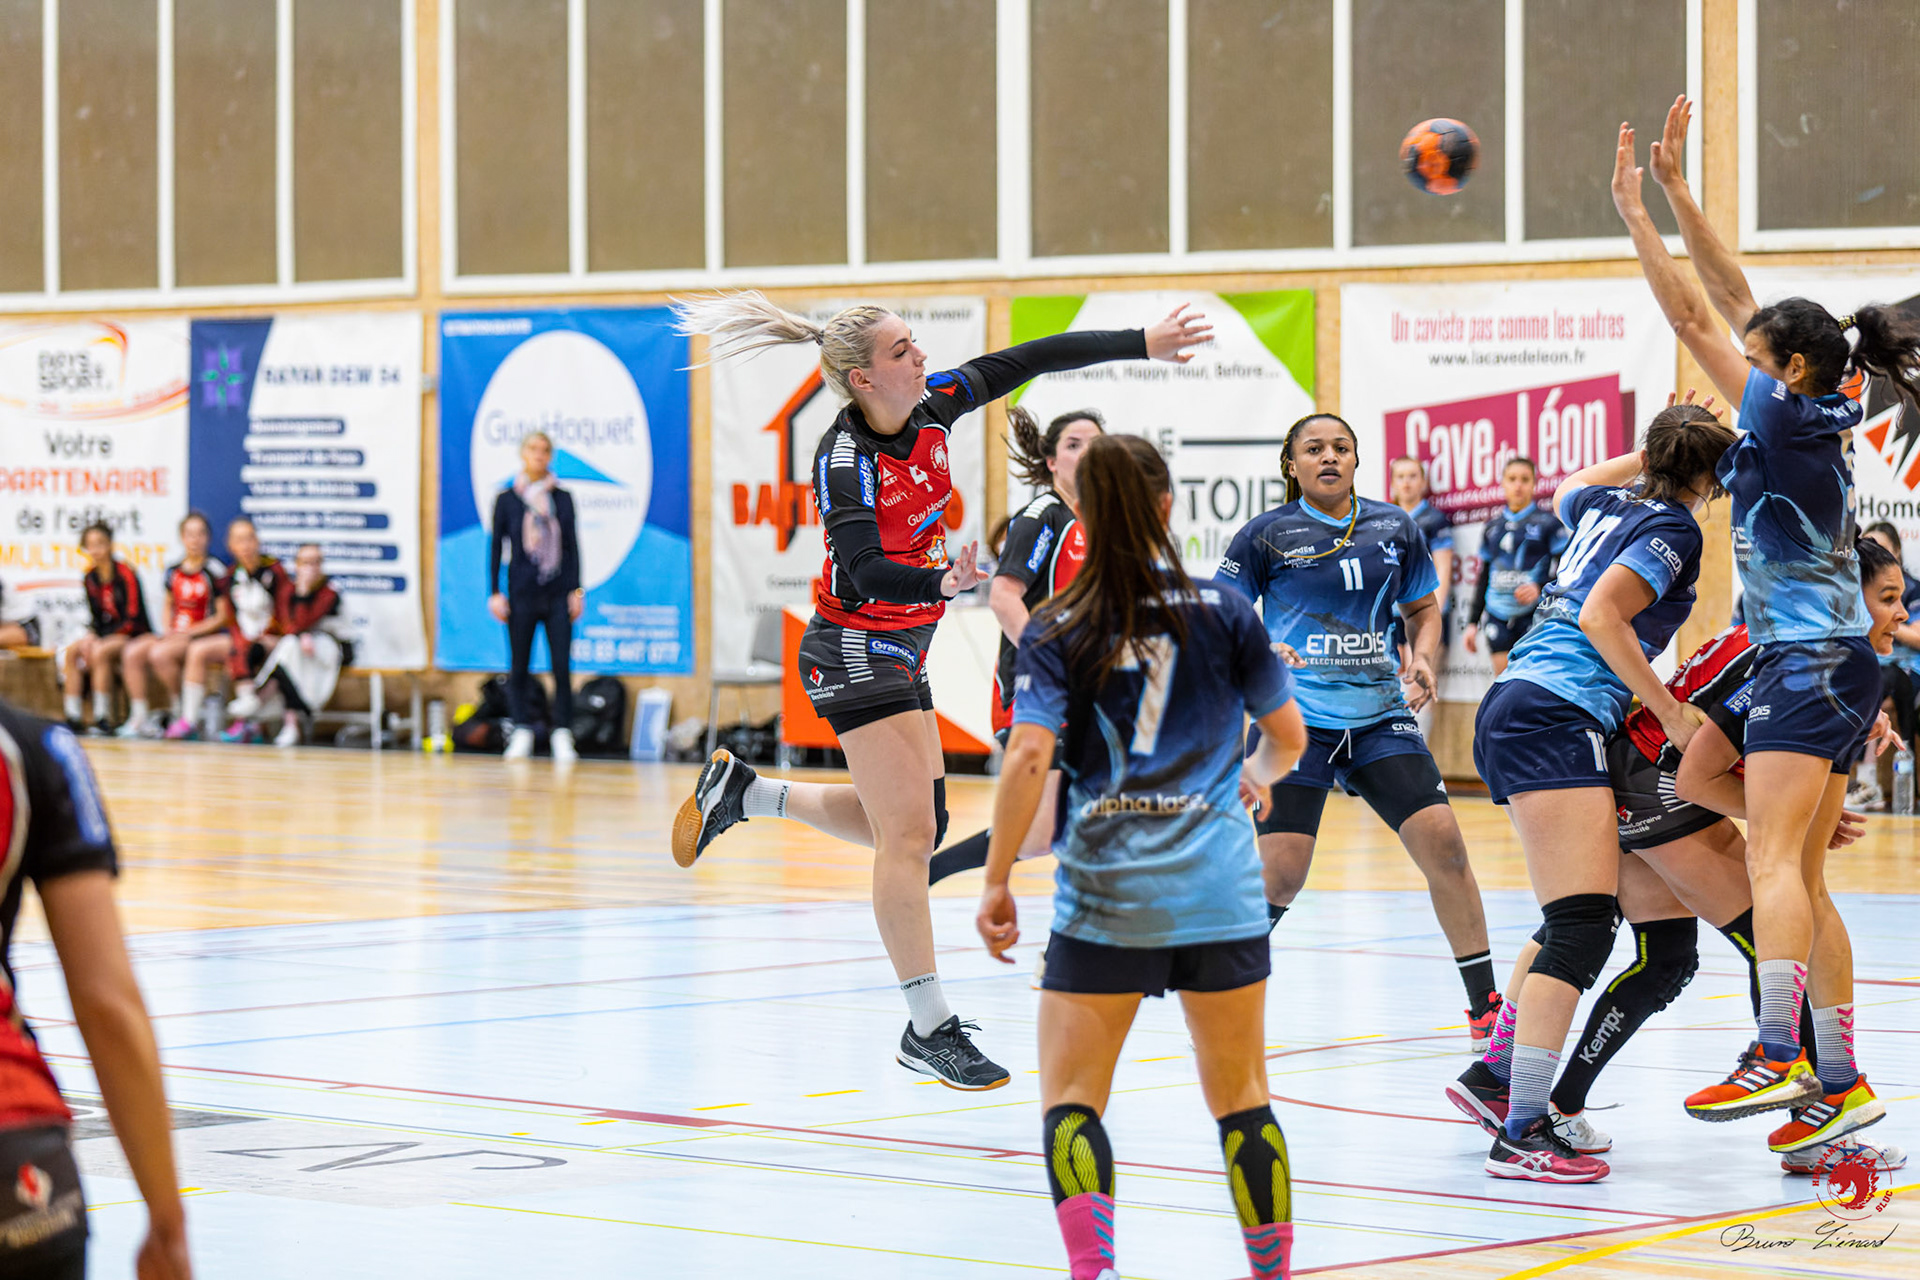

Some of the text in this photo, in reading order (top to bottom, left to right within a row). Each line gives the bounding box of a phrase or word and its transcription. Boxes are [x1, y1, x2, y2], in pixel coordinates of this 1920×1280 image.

[1391, 309, 1624, 344] Un caviste pas comme les autres
[1428, 348, 1586, 367] www.lacavedeleon.fr
[43, 430, 112, 458] Votre
[1404, 408, 1496, 494] Cave
[1517, 386, 1608, 478] Léon
[908, 464, 934, 493] 4
[907, 510, 927, 527] Guy
[1339, 557, 1364, 591] 11
[1112, 633, 1179, 757] 7
